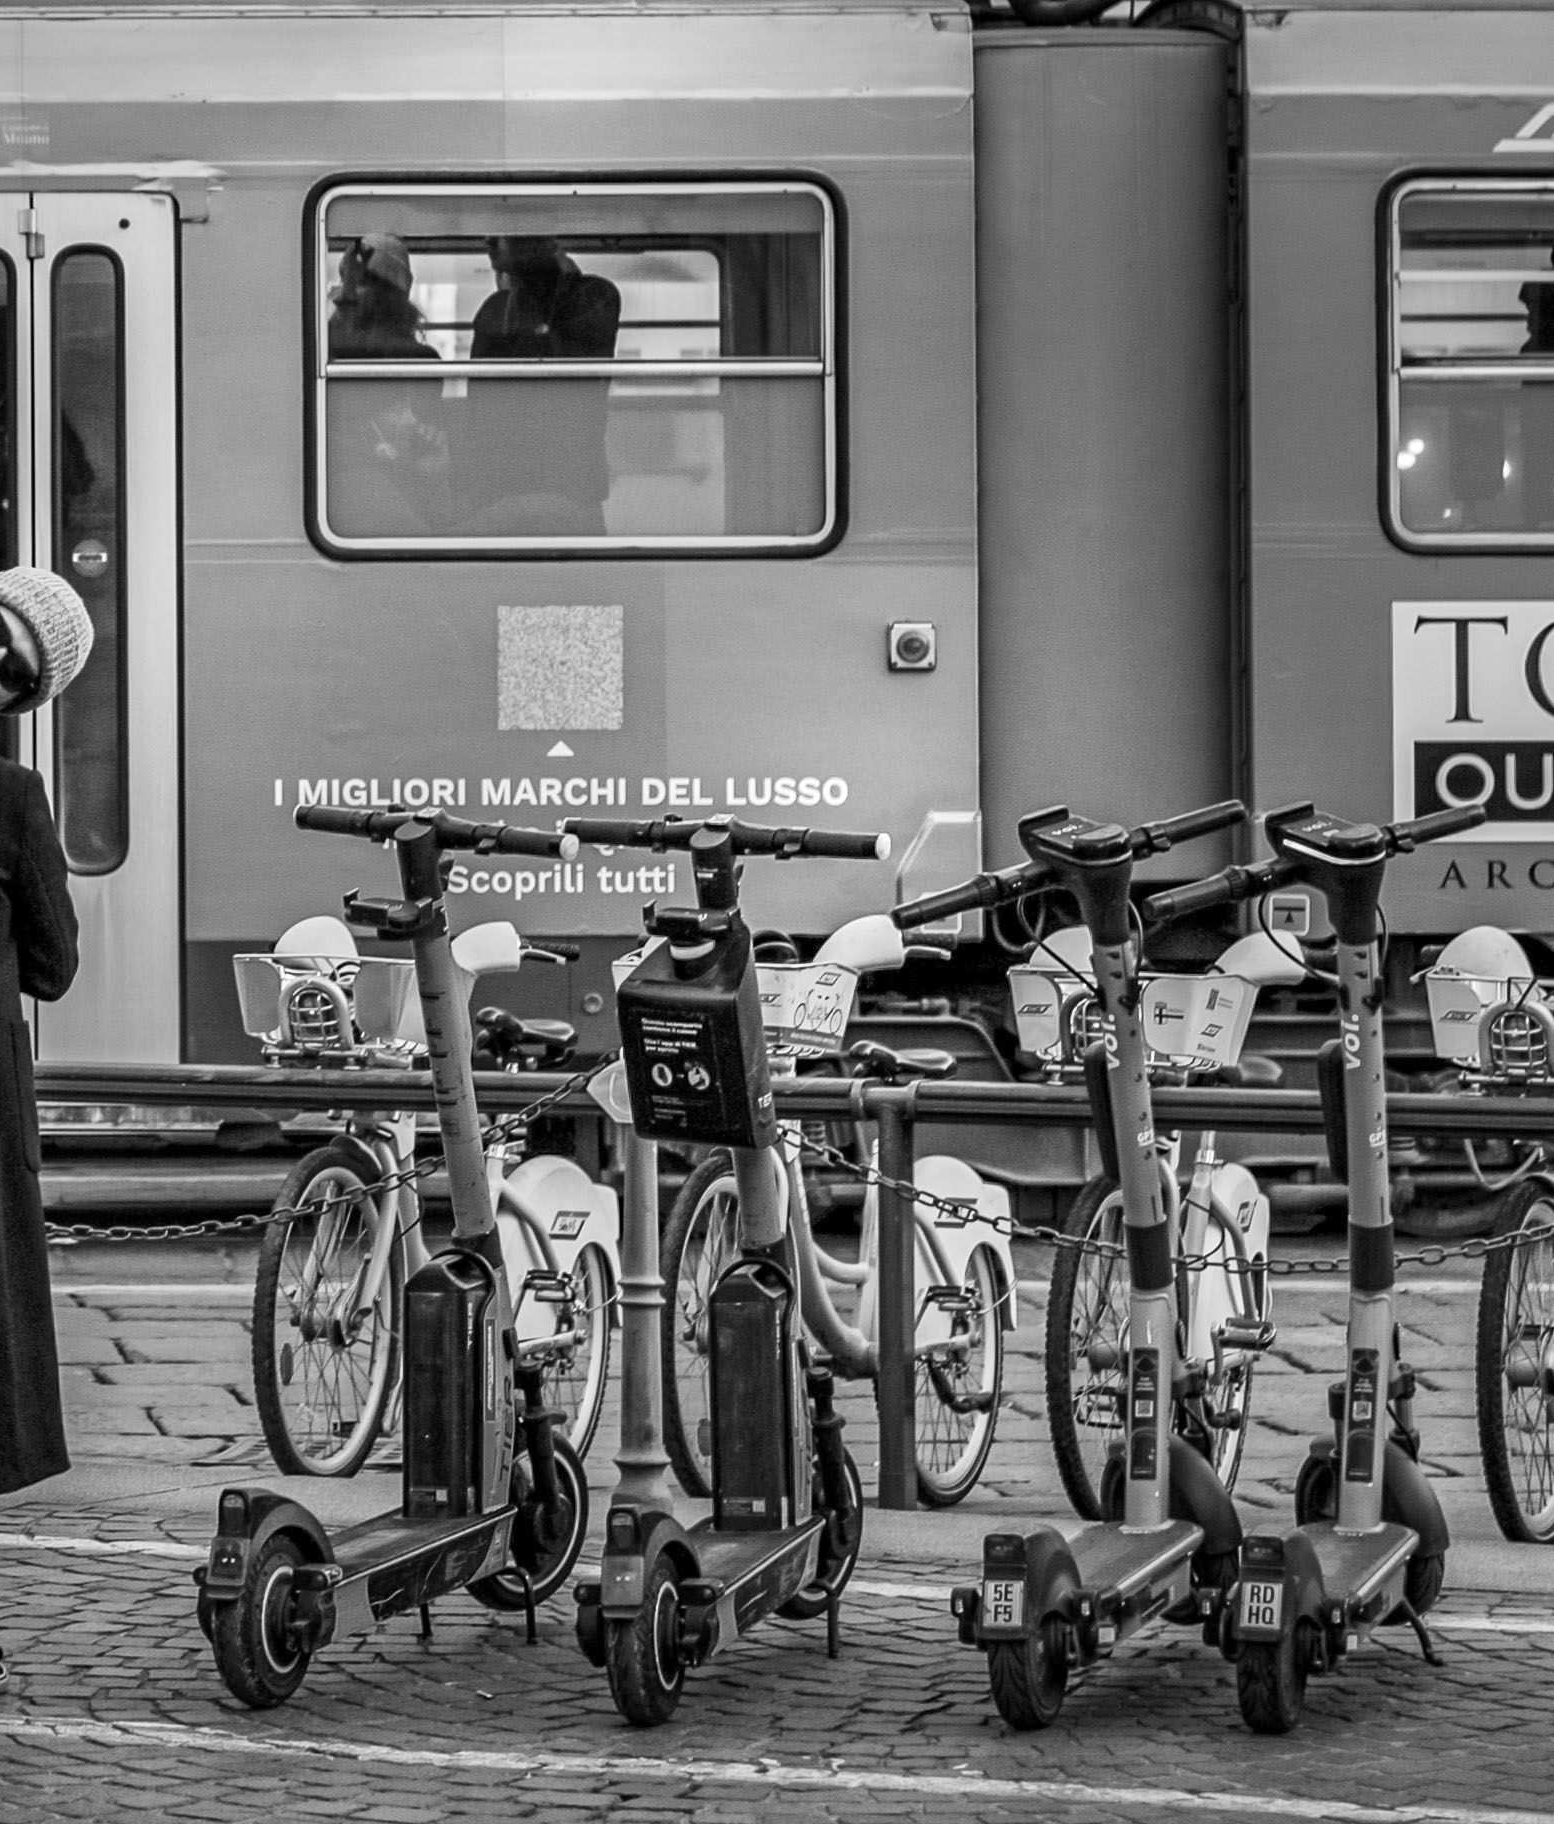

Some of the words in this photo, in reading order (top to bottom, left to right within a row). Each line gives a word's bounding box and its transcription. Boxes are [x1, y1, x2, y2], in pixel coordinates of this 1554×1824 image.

[274, 779, 284, 807] I
[297, 778, 466, 807] MIGLIORI
[480, 777, 627, 806] MARCHI
[641, 777, 720, 806] DEL
[725, 777, 849, 806] LUSSO
[447, 864, 585, 900] Scoprili
[597, 864, 676, 894] tutti
[1340, 1013, 1361, 1070] voi.
[993, 1583, 1014, 1602] 5E
[1249, 1584, 1275, 1604] RD
[993, 1604, 1013, 1623] F5
[1247, 1606, 1275, 1625] HQ
